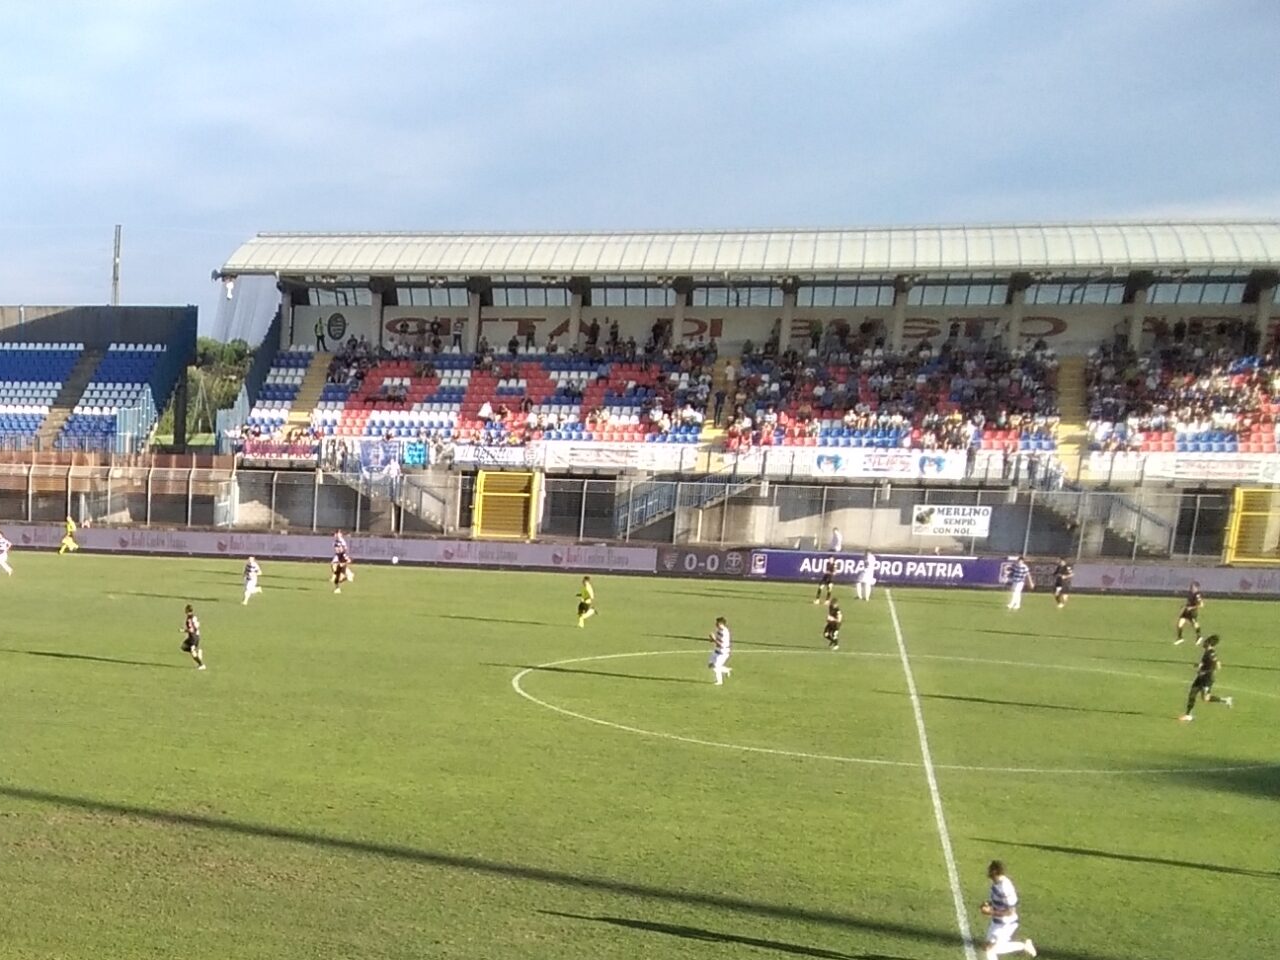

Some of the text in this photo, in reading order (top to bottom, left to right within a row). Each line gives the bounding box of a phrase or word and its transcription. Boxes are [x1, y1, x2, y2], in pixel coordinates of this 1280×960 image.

[936, 507, 990, 517] MERLINO
[684, 553, 719, 571] 0-0
[800, 557, 864, 573] AUORA
[905, 560, 964, 578] PATRIA
